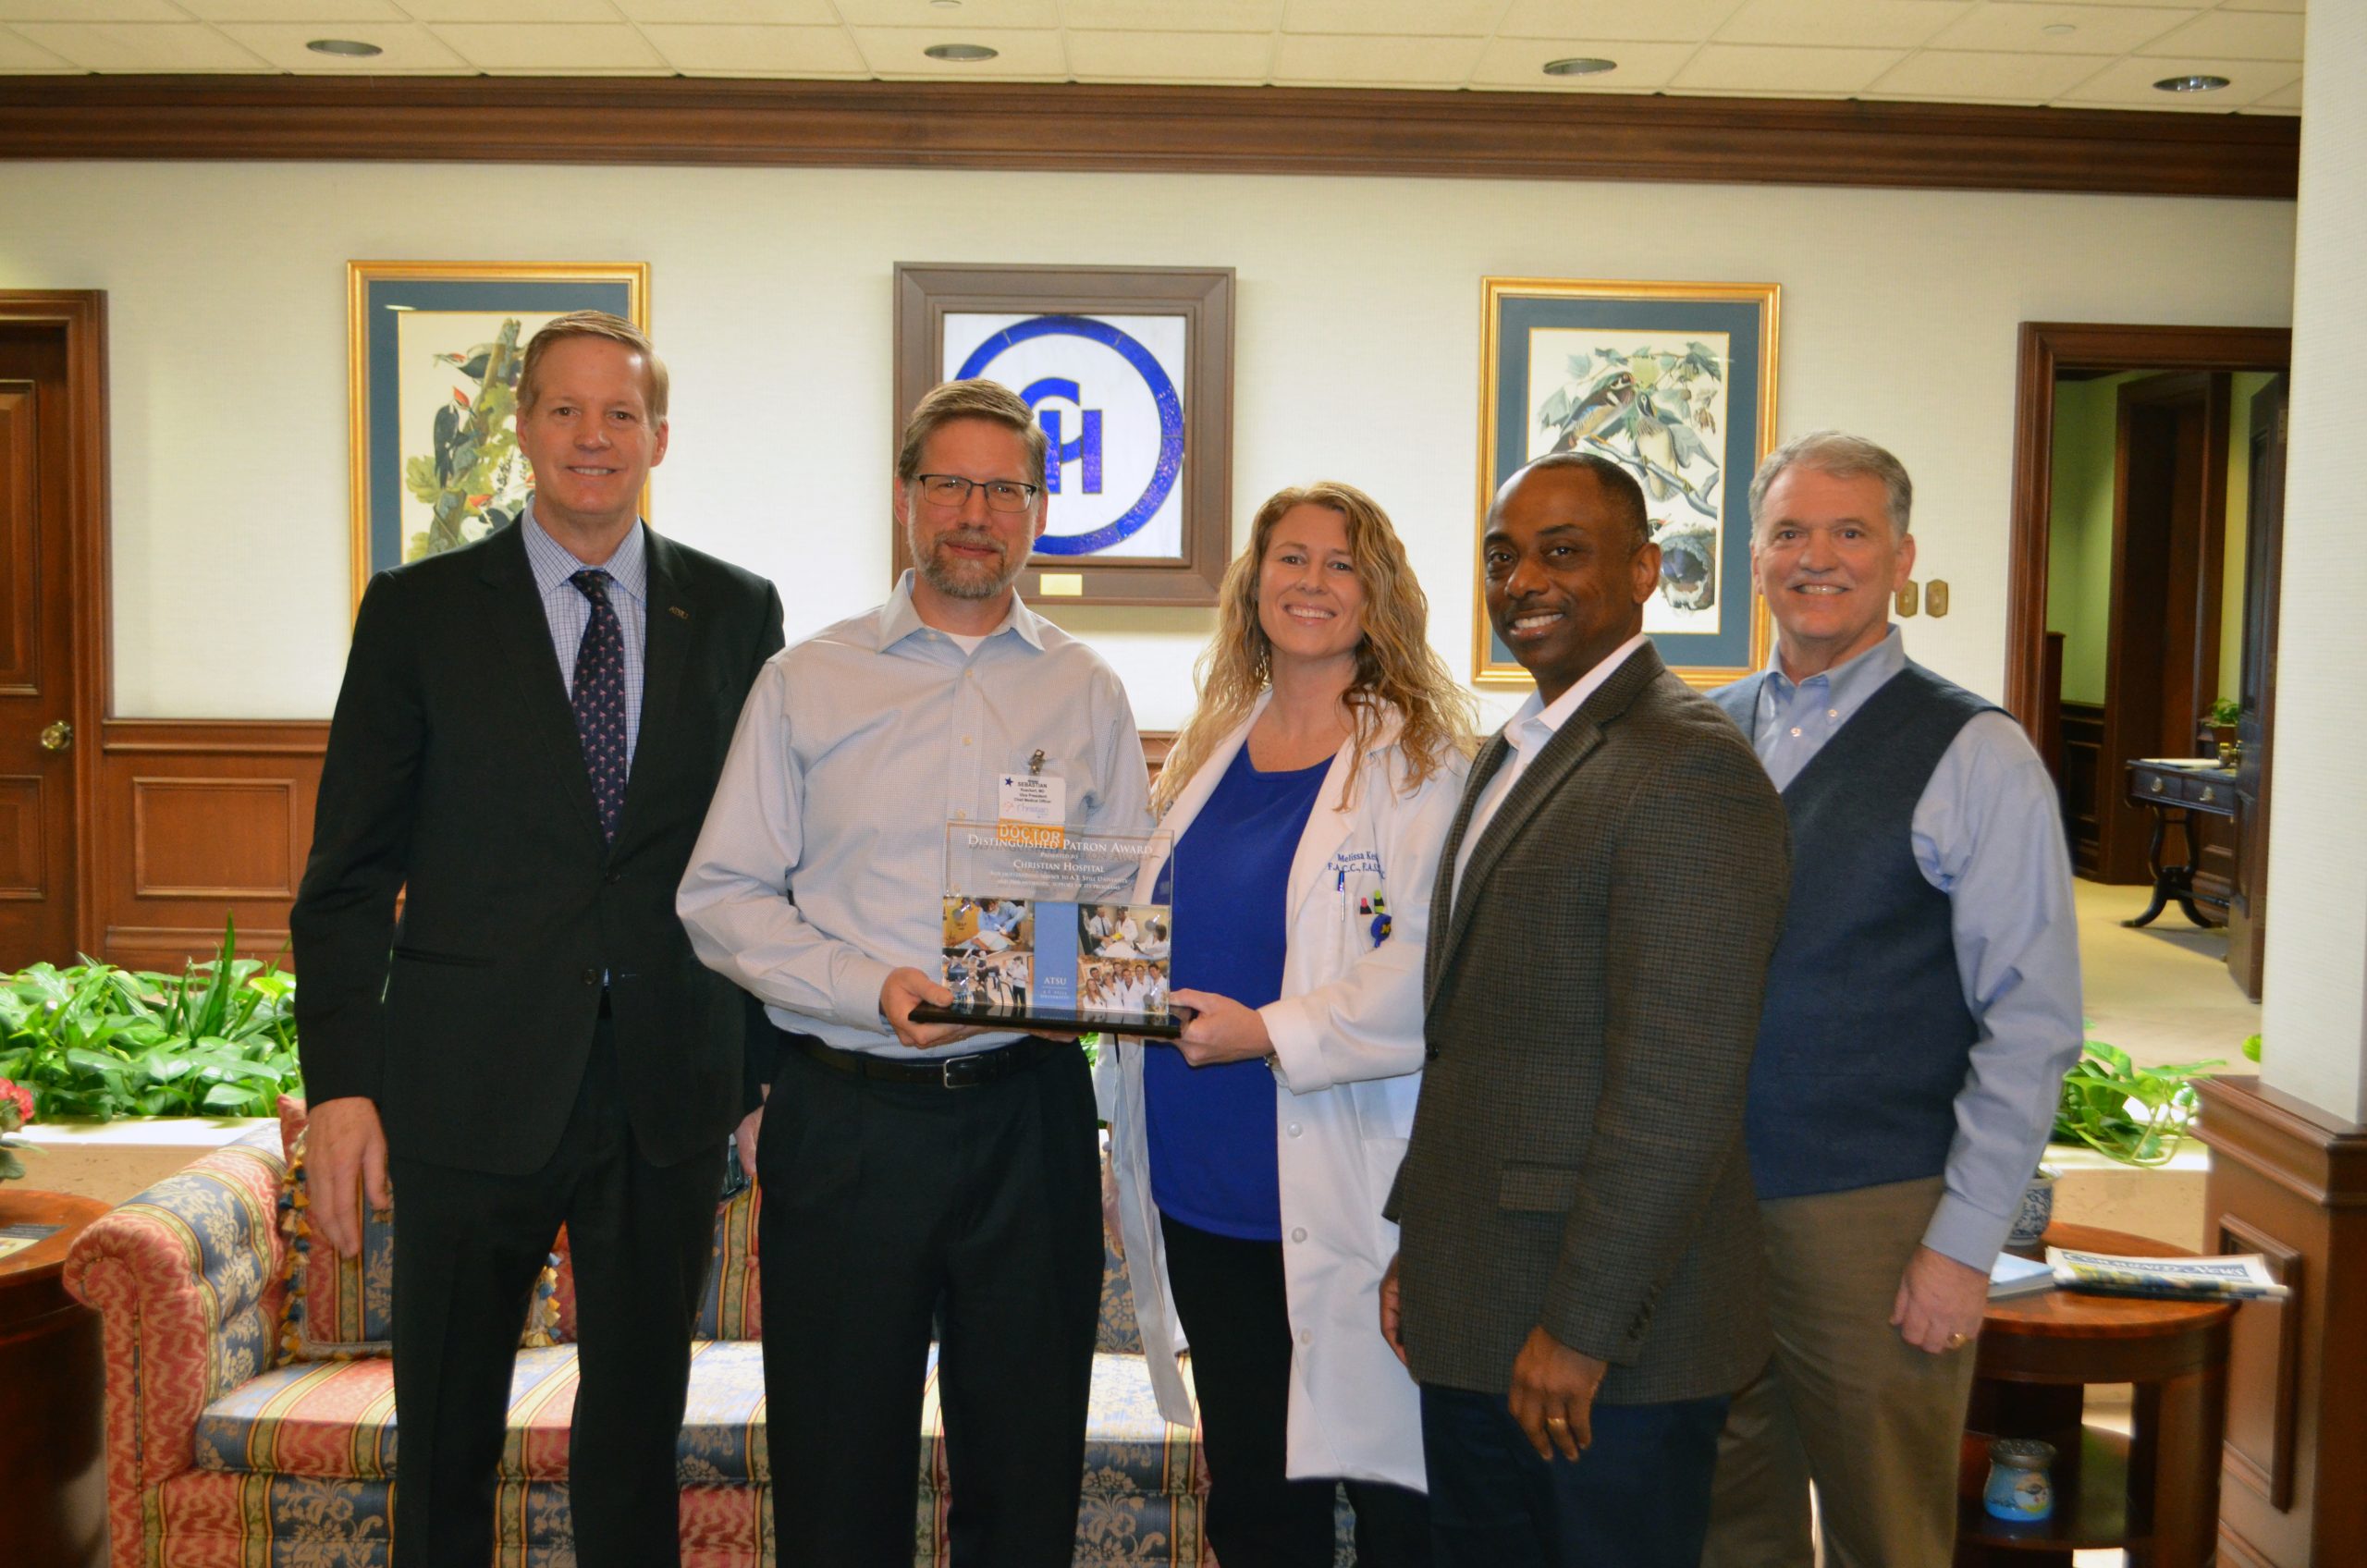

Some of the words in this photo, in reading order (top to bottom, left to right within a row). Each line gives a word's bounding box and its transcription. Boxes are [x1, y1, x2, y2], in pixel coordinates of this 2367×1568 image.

[999, 824, 1061, 844] DOCTOR
[968, 834, 1059, 850] DISTINGUISHED
[1063, 839, 1107, 851] PATRON
[1111, 842, 1154, 854] AWARD
[1337, 851, 1365, 863] Melissa
[1013, 859, 1061, 870] CHRISTIAN
[1063, 862, 1105, 873] HOSPITAL
[1044, 976, 1067, 986] ATSU
